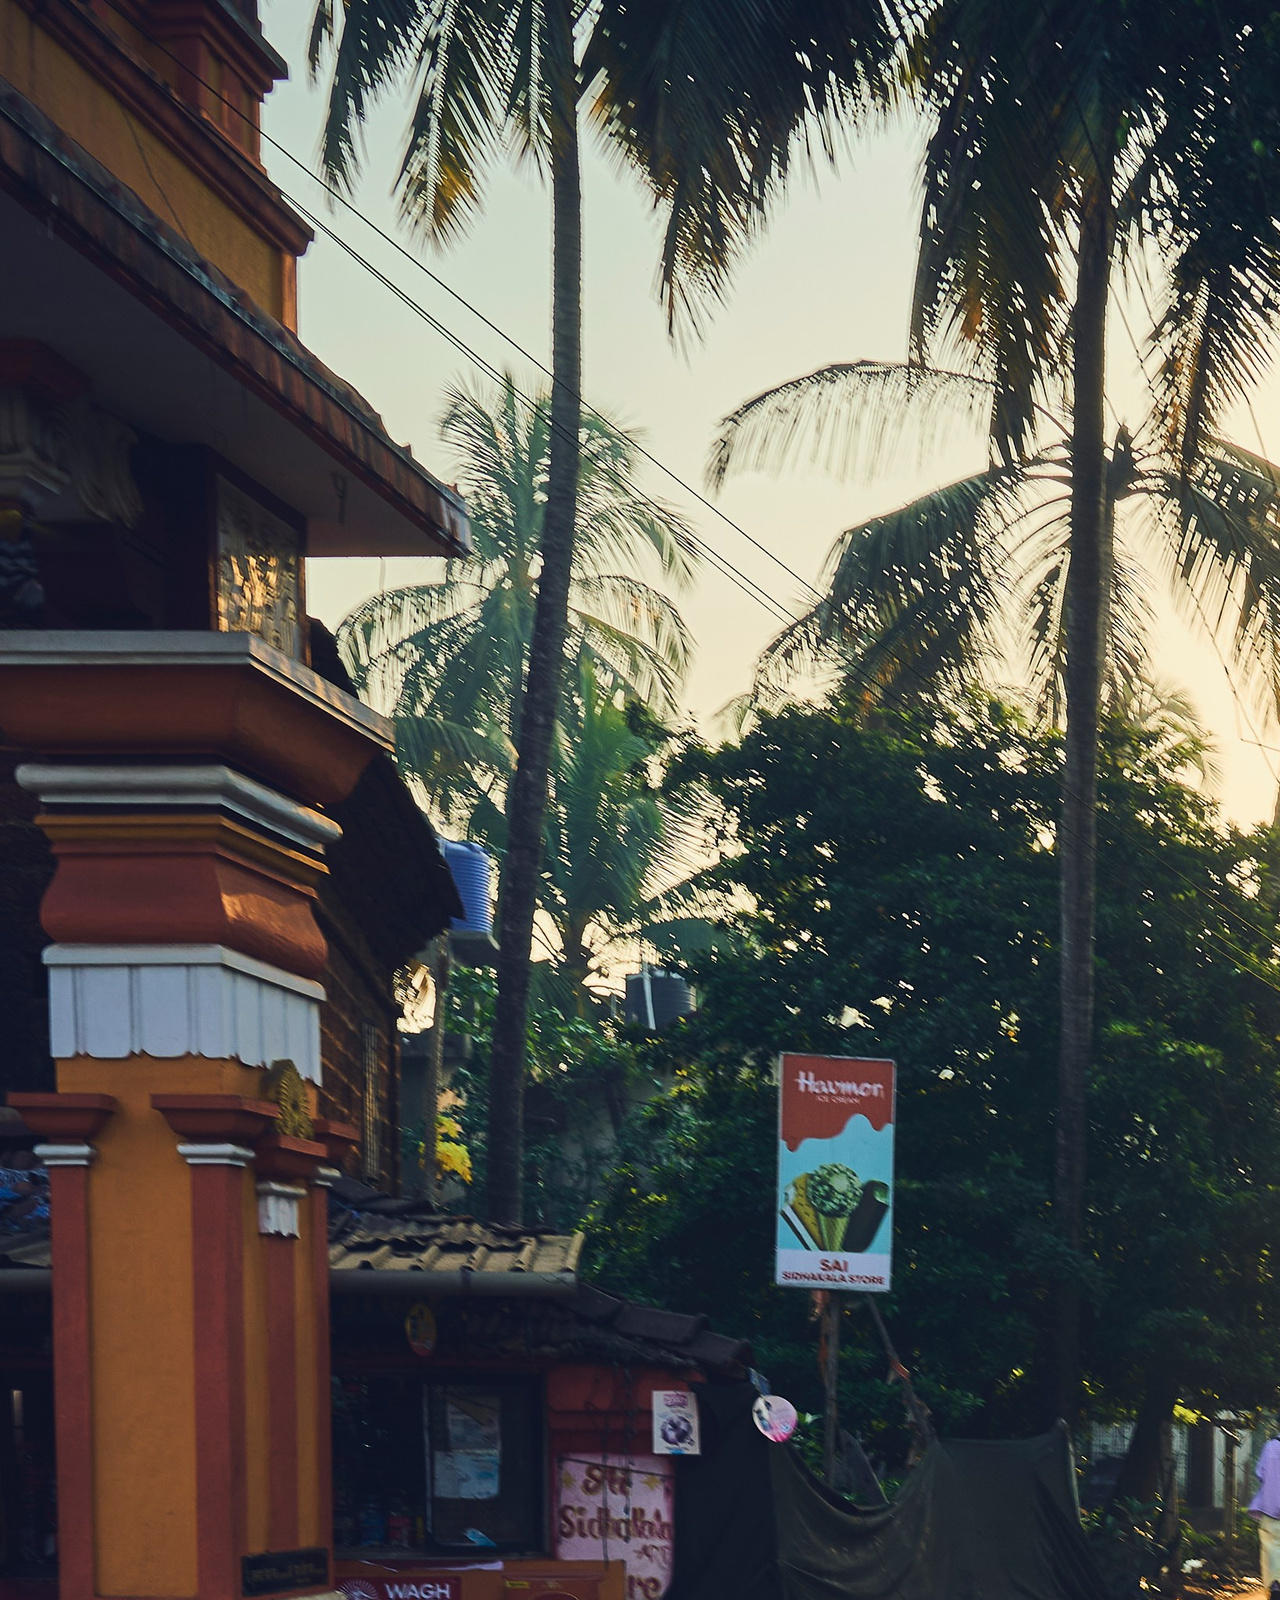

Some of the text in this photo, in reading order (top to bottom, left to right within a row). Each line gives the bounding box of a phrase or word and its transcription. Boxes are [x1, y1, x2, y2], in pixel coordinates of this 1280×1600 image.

[794, 1071, 884, 1098] Havmor
[819, 1258, 849, 1273] SAI
[848, 1273, 886, 1286] STORE
[384, 1582, 451, 1599] WAGH
